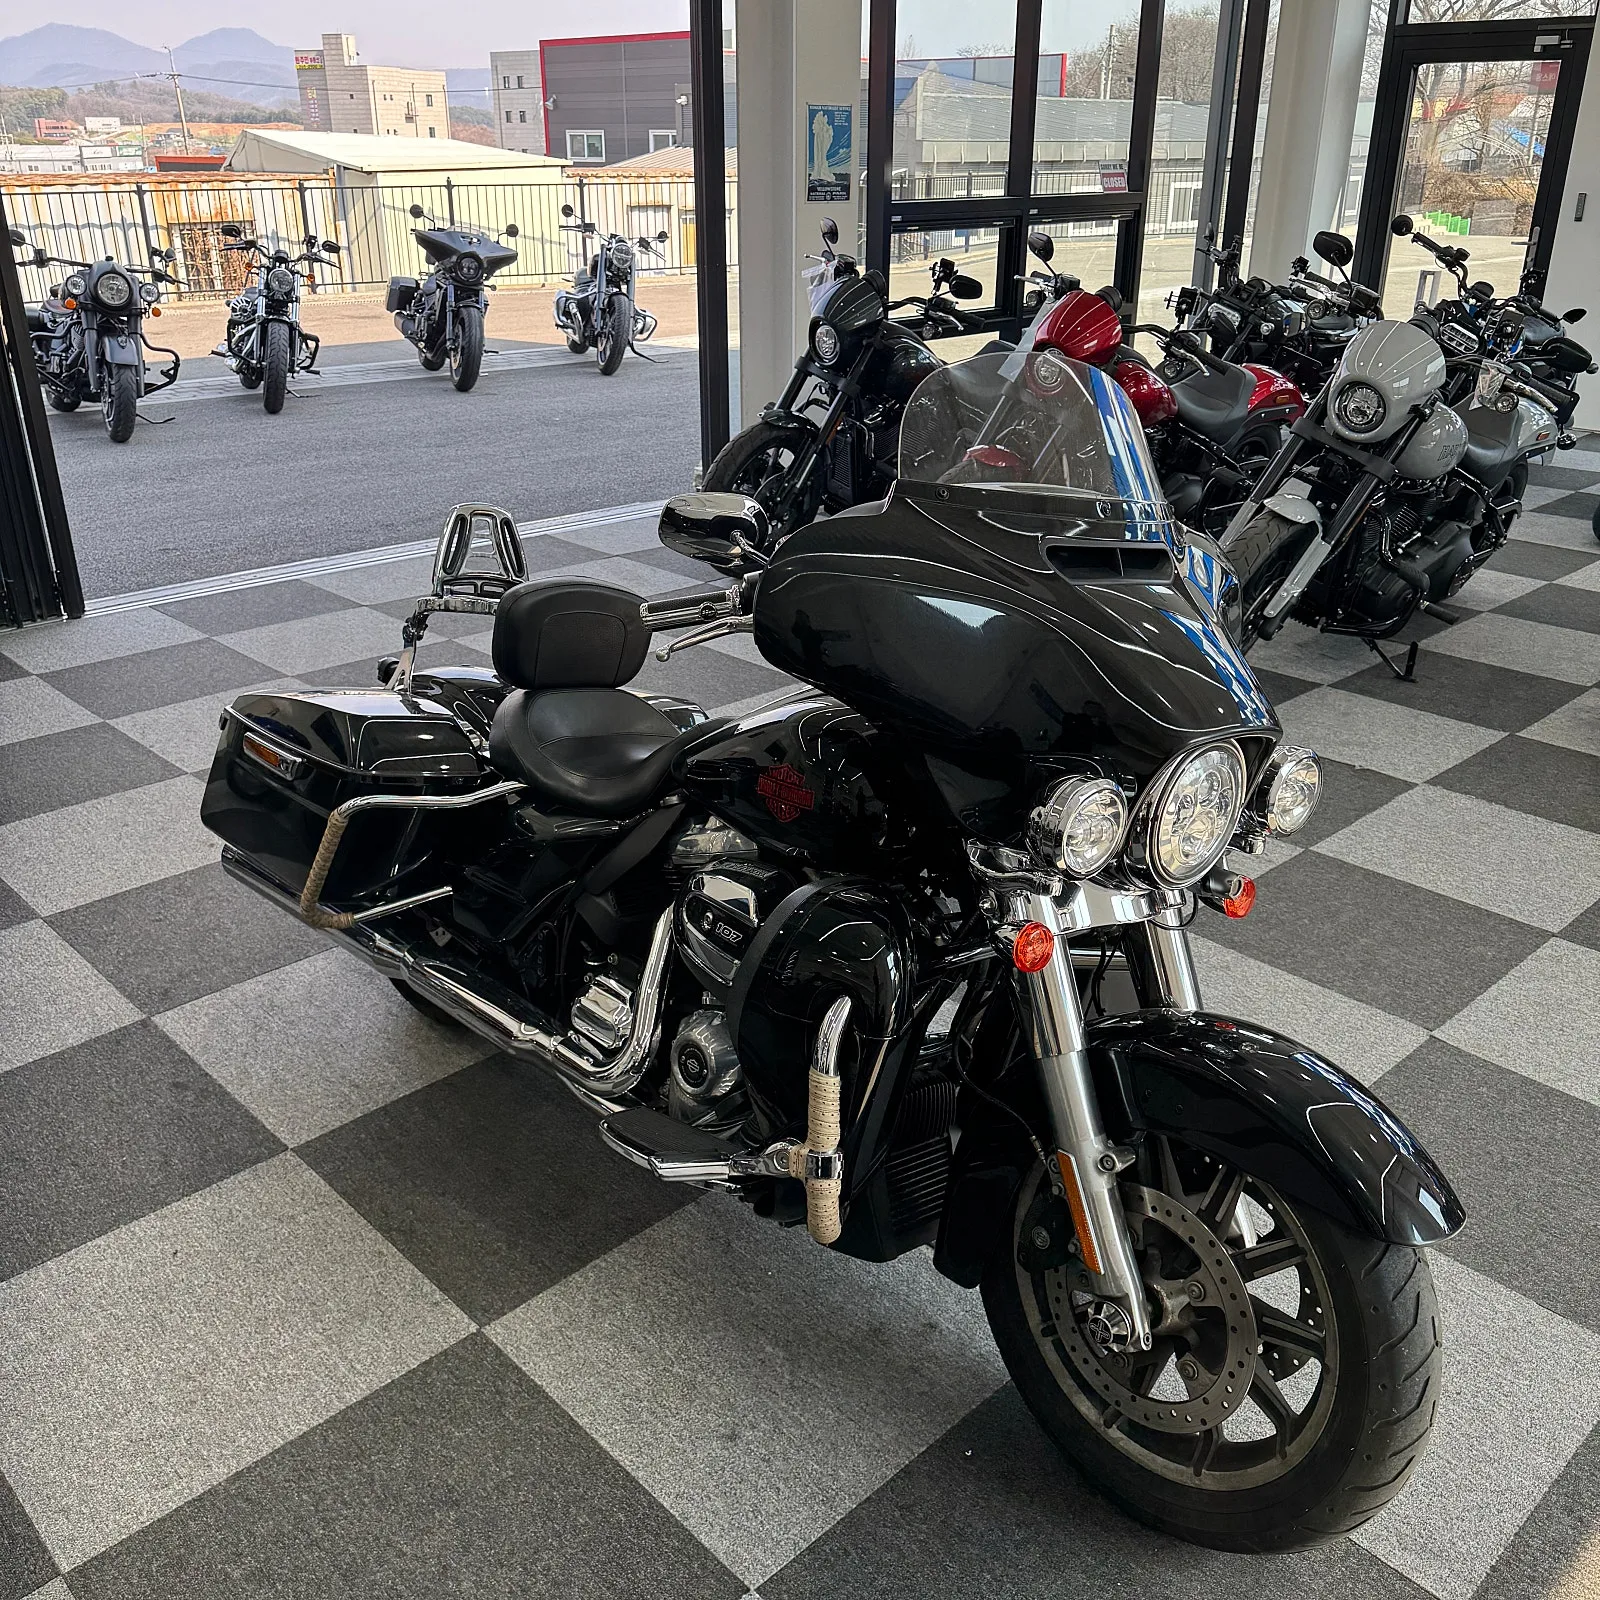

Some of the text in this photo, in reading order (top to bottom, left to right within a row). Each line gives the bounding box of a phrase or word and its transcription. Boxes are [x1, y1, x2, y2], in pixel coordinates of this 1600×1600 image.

[1103, 177, 1126, 188] CLOSED
[772, 767, 802, 785] MOTOR
[715, 921, 743, 943] 107
